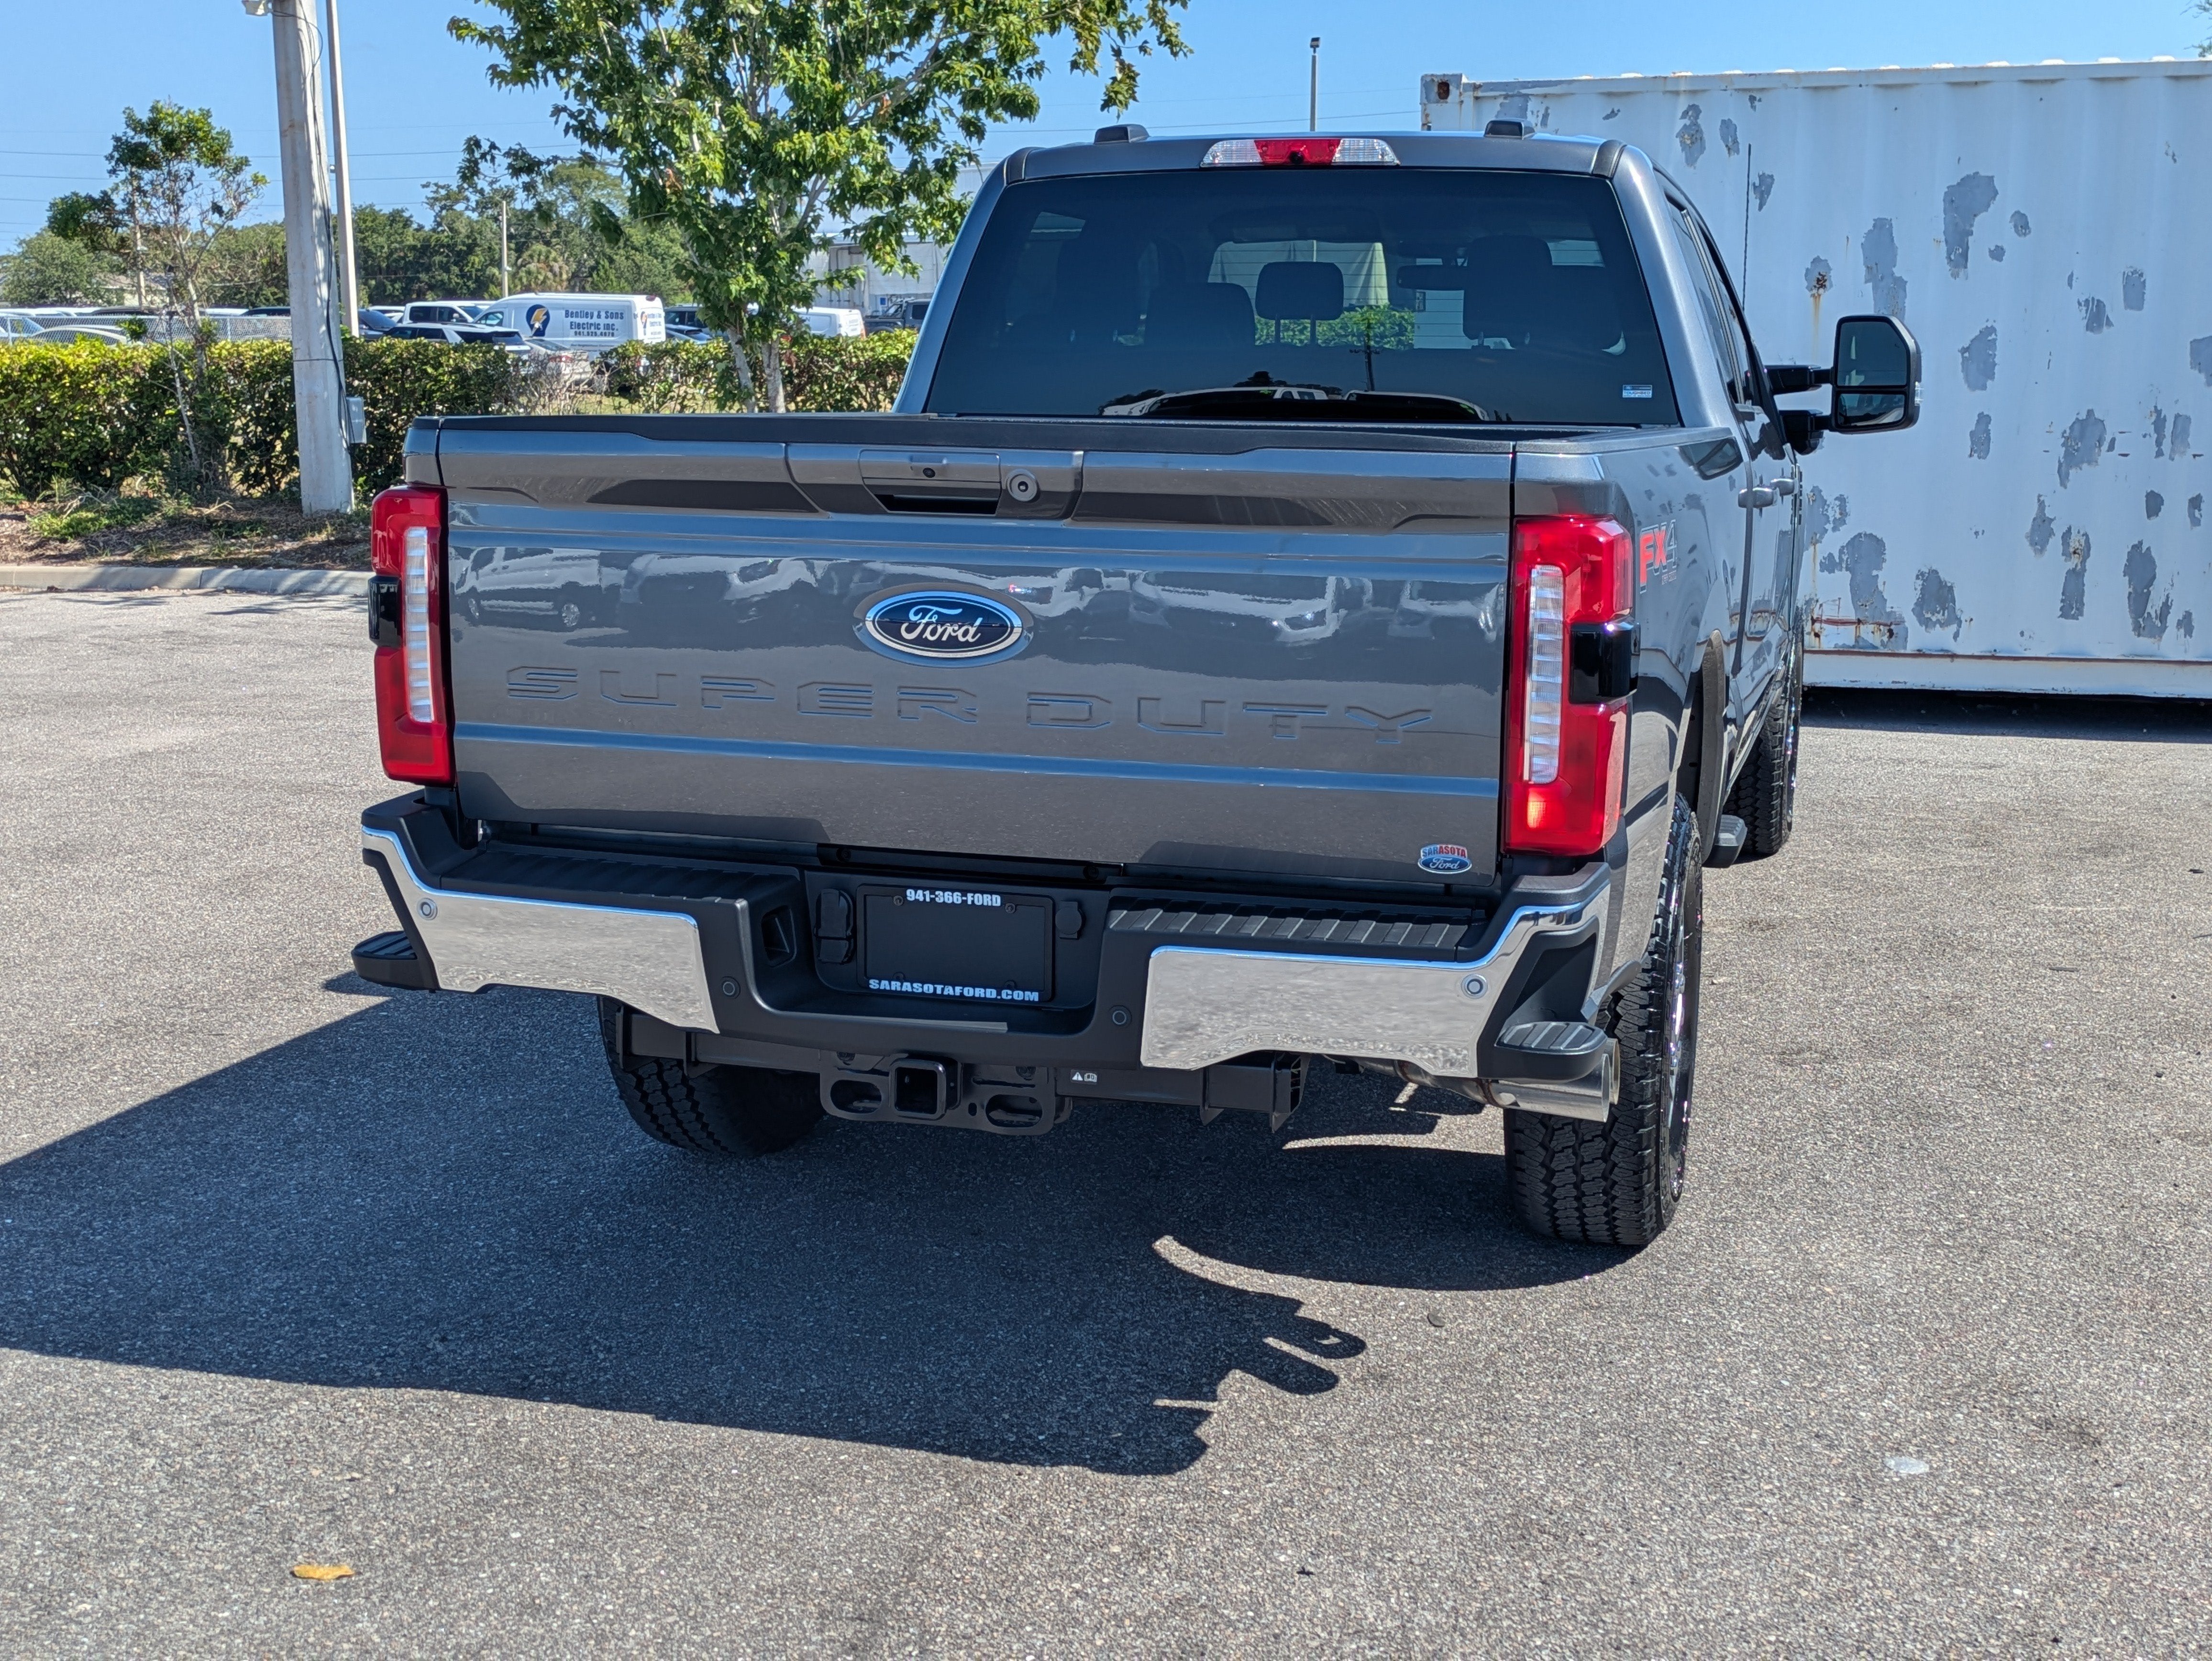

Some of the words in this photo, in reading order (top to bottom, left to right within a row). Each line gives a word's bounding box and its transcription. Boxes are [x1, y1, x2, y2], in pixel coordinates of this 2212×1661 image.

[564, 310, 594, 320] Bentley
[597, 310, 601, 319] &
[605, 311, 624, 320] Sons
[570, 321, 601, 330] Electric
[1640, 519, 1677, 594] FX4
[900, 605, 983, 642] Ford
[507, 666, 977, 723] SUPER
[1026, 692, 1432, 744] DUTY
[1422, 845, 1466, 858] SARASOTA
[1429, 857, 1460, 869] Ford
[906, 889, 1001, 907] 941-366-FORD
[869, 979, 1039, 1002] SARASOTAFORD.COM
